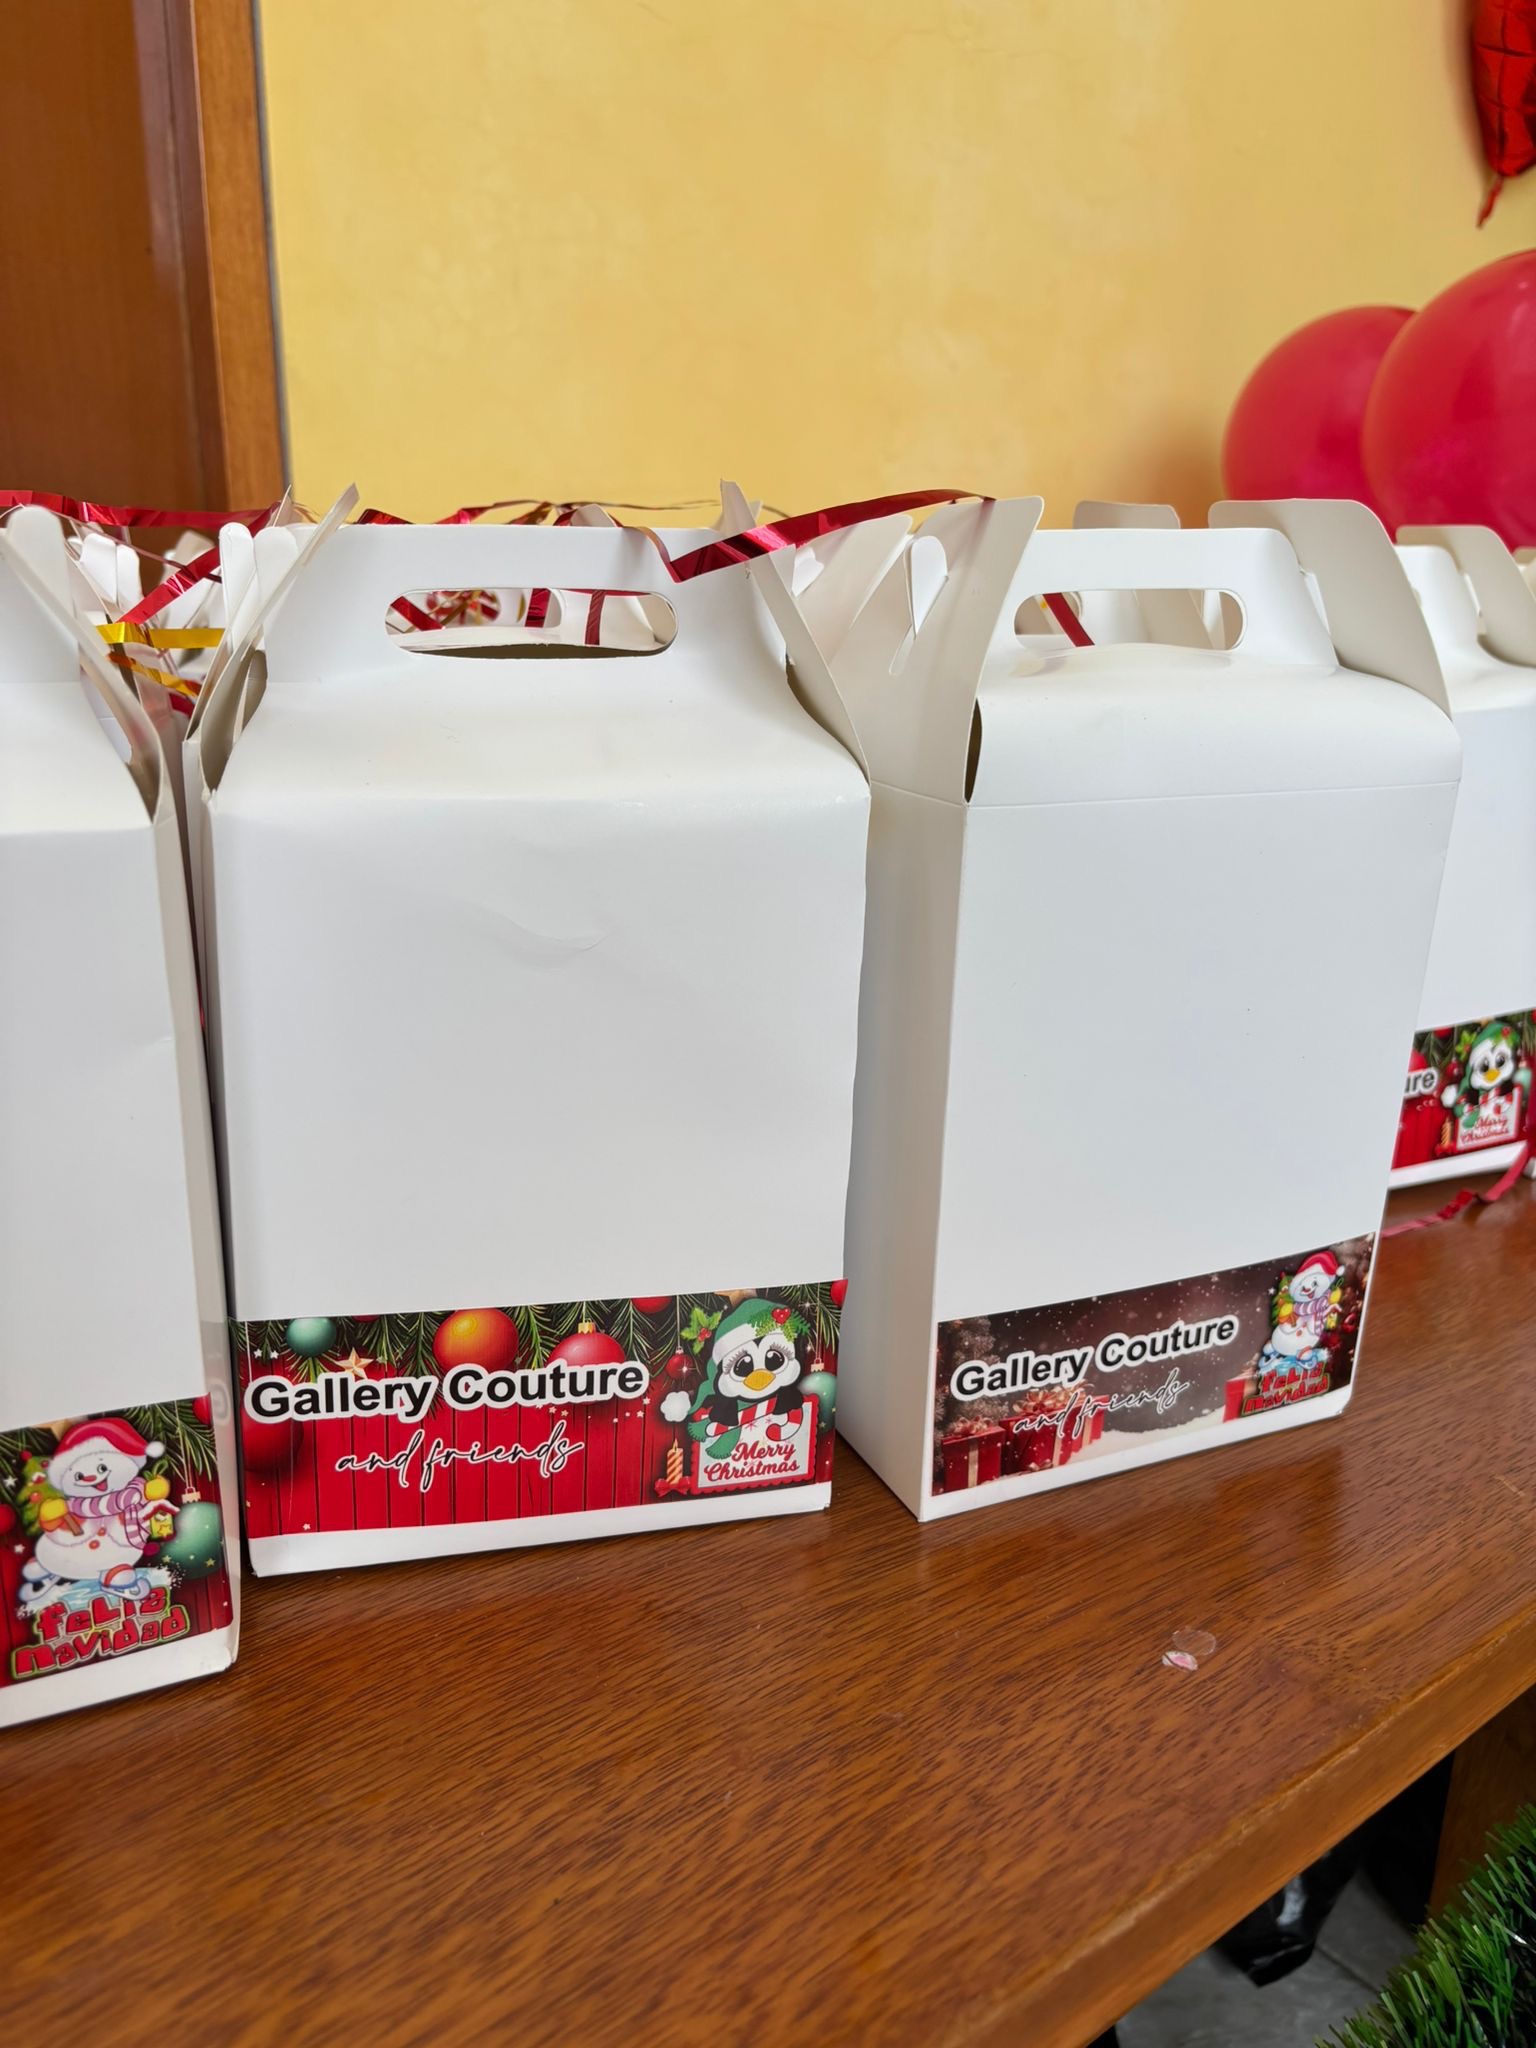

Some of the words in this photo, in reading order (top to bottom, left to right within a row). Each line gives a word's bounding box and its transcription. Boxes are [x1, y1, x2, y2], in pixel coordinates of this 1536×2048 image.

[956, 1350, 1089, 1396] Gallery
[1101, 1319, 1235, 1366] Couture
[250, 1376, 433, 1418] Gallery
[448, 1363, 645, 1406] Couture
[1013, 1391, 1079, 1438] and
[1072, 1367, 1190, 1440] friends
[336, 1429, 425, 1488] and
[420, 1420, 584, 1493] friends
[704, 1458, 799, 1482] Christmas
[731, 1440, 797, 1462] Merry
